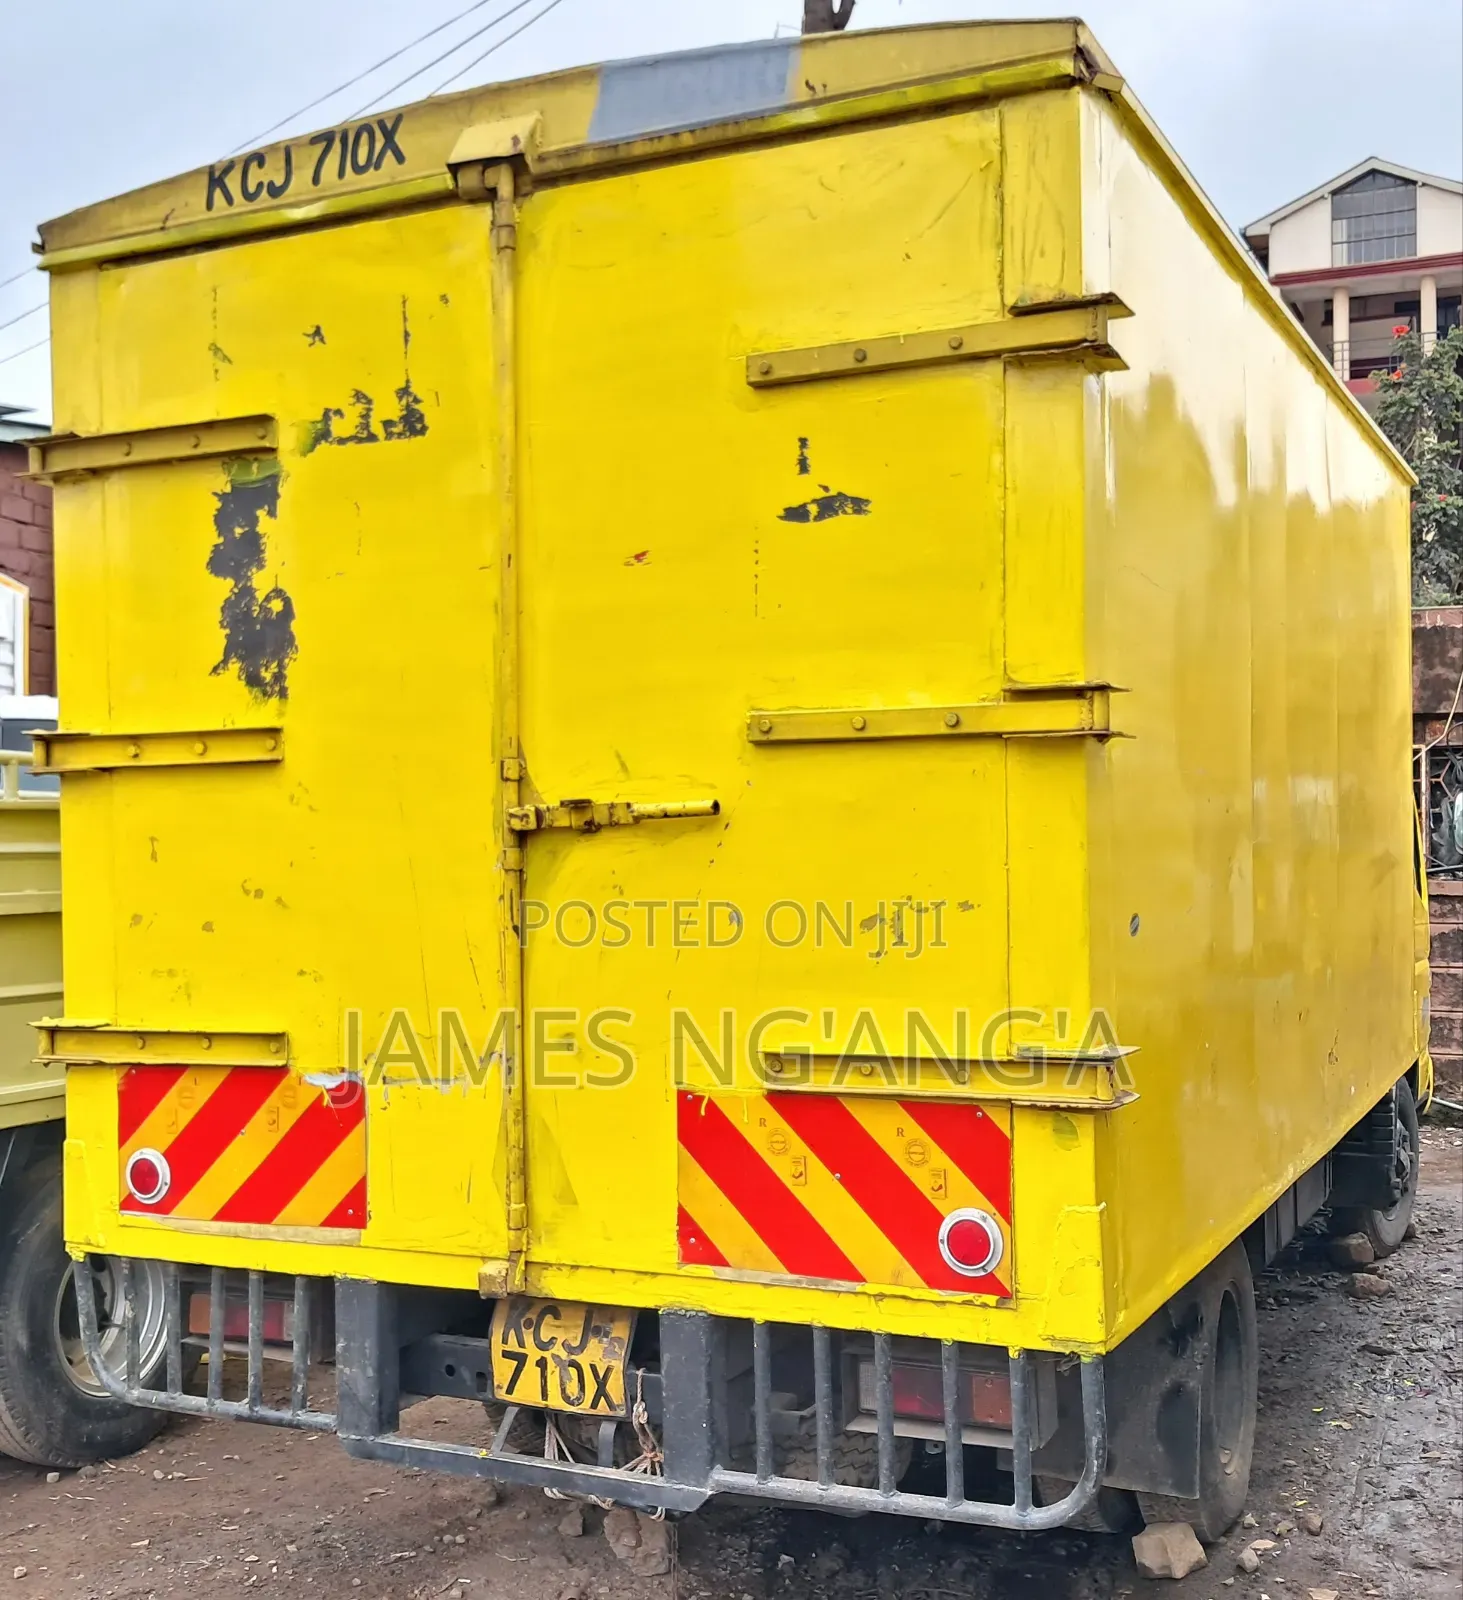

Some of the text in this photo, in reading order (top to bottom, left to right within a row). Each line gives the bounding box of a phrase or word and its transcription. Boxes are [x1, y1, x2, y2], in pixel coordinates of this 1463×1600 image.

[206, 113, 406, 211] KCJ 710X
[501, 1301, 595, 1356] KCJ
[501, 1349, 618, 1412] 710X
